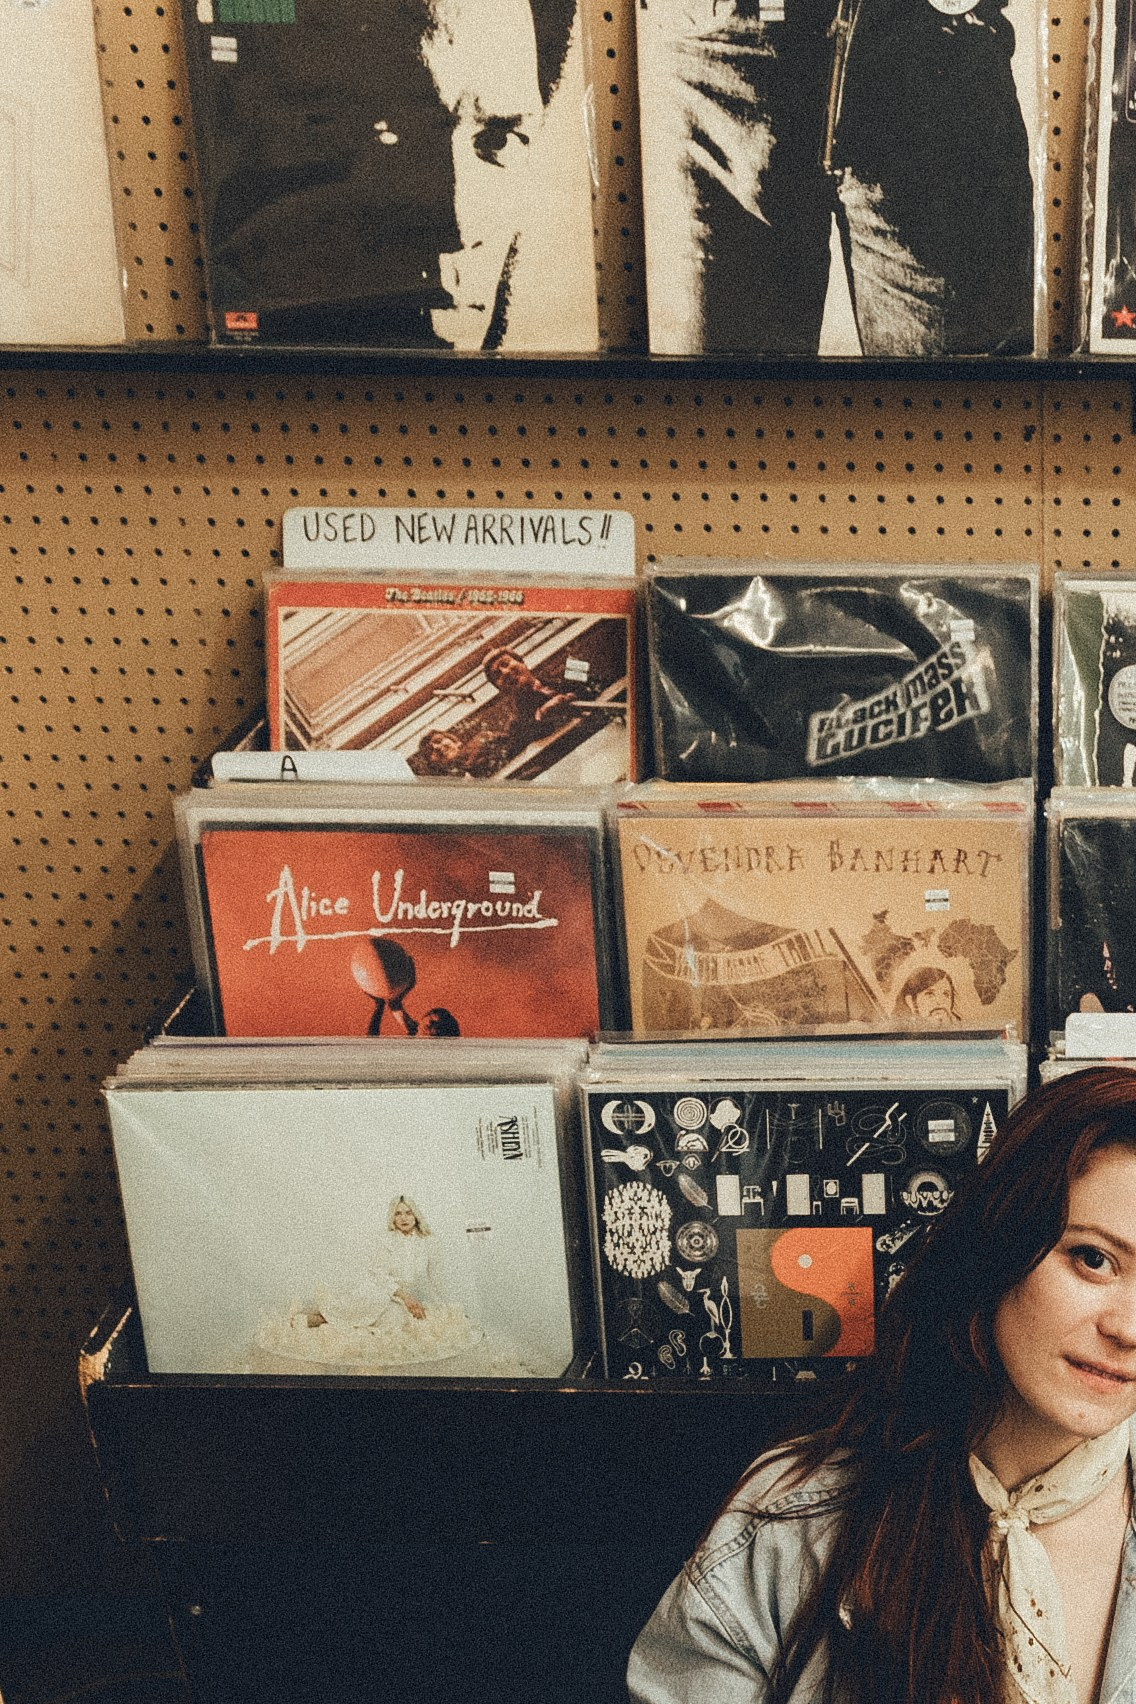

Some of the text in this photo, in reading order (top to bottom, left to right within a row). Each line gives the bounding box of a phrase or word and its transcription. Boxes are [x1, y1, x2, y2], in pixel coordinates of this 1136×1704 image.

[303, 511, 376, 542] USED
[394, 512, 456, 545] NEW
[281, 755, 298, 781] A
[828, 838, 1003, 878] BANHART
[266, 864, 543, 956] Alice Underground
